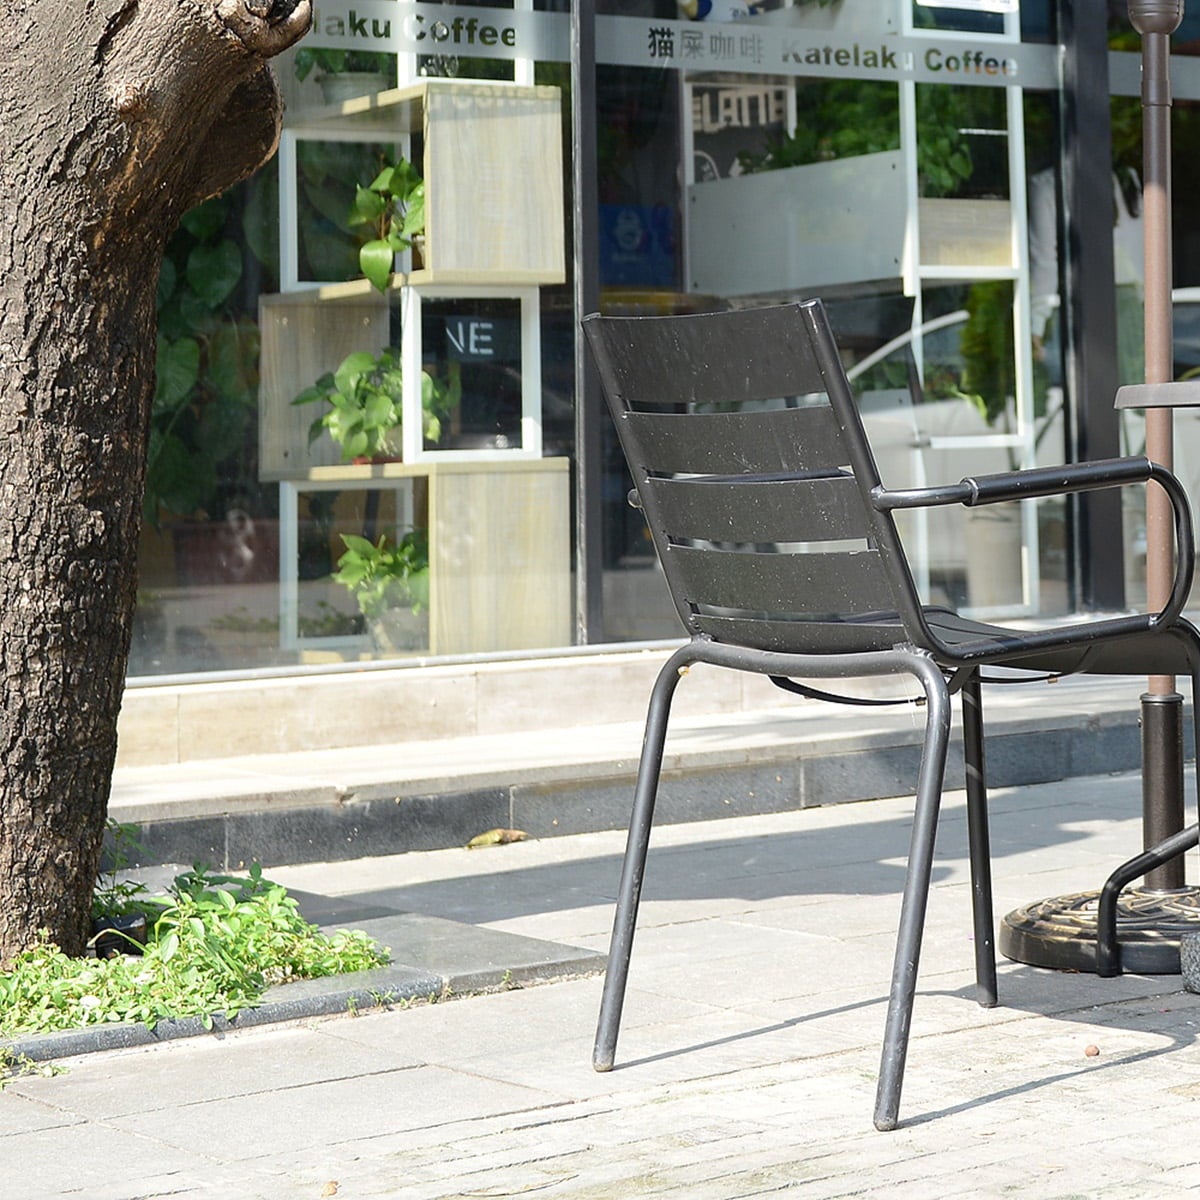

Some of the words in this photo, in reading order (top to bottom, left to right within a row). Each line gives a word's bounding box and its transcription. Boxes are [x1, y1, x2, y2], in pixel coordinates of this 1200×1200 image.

[403, 13, 516, 48] Coffee
[647, 26, 764, 64] 猫屎咖啡
[924, 47, 1019, 77] Coffee
